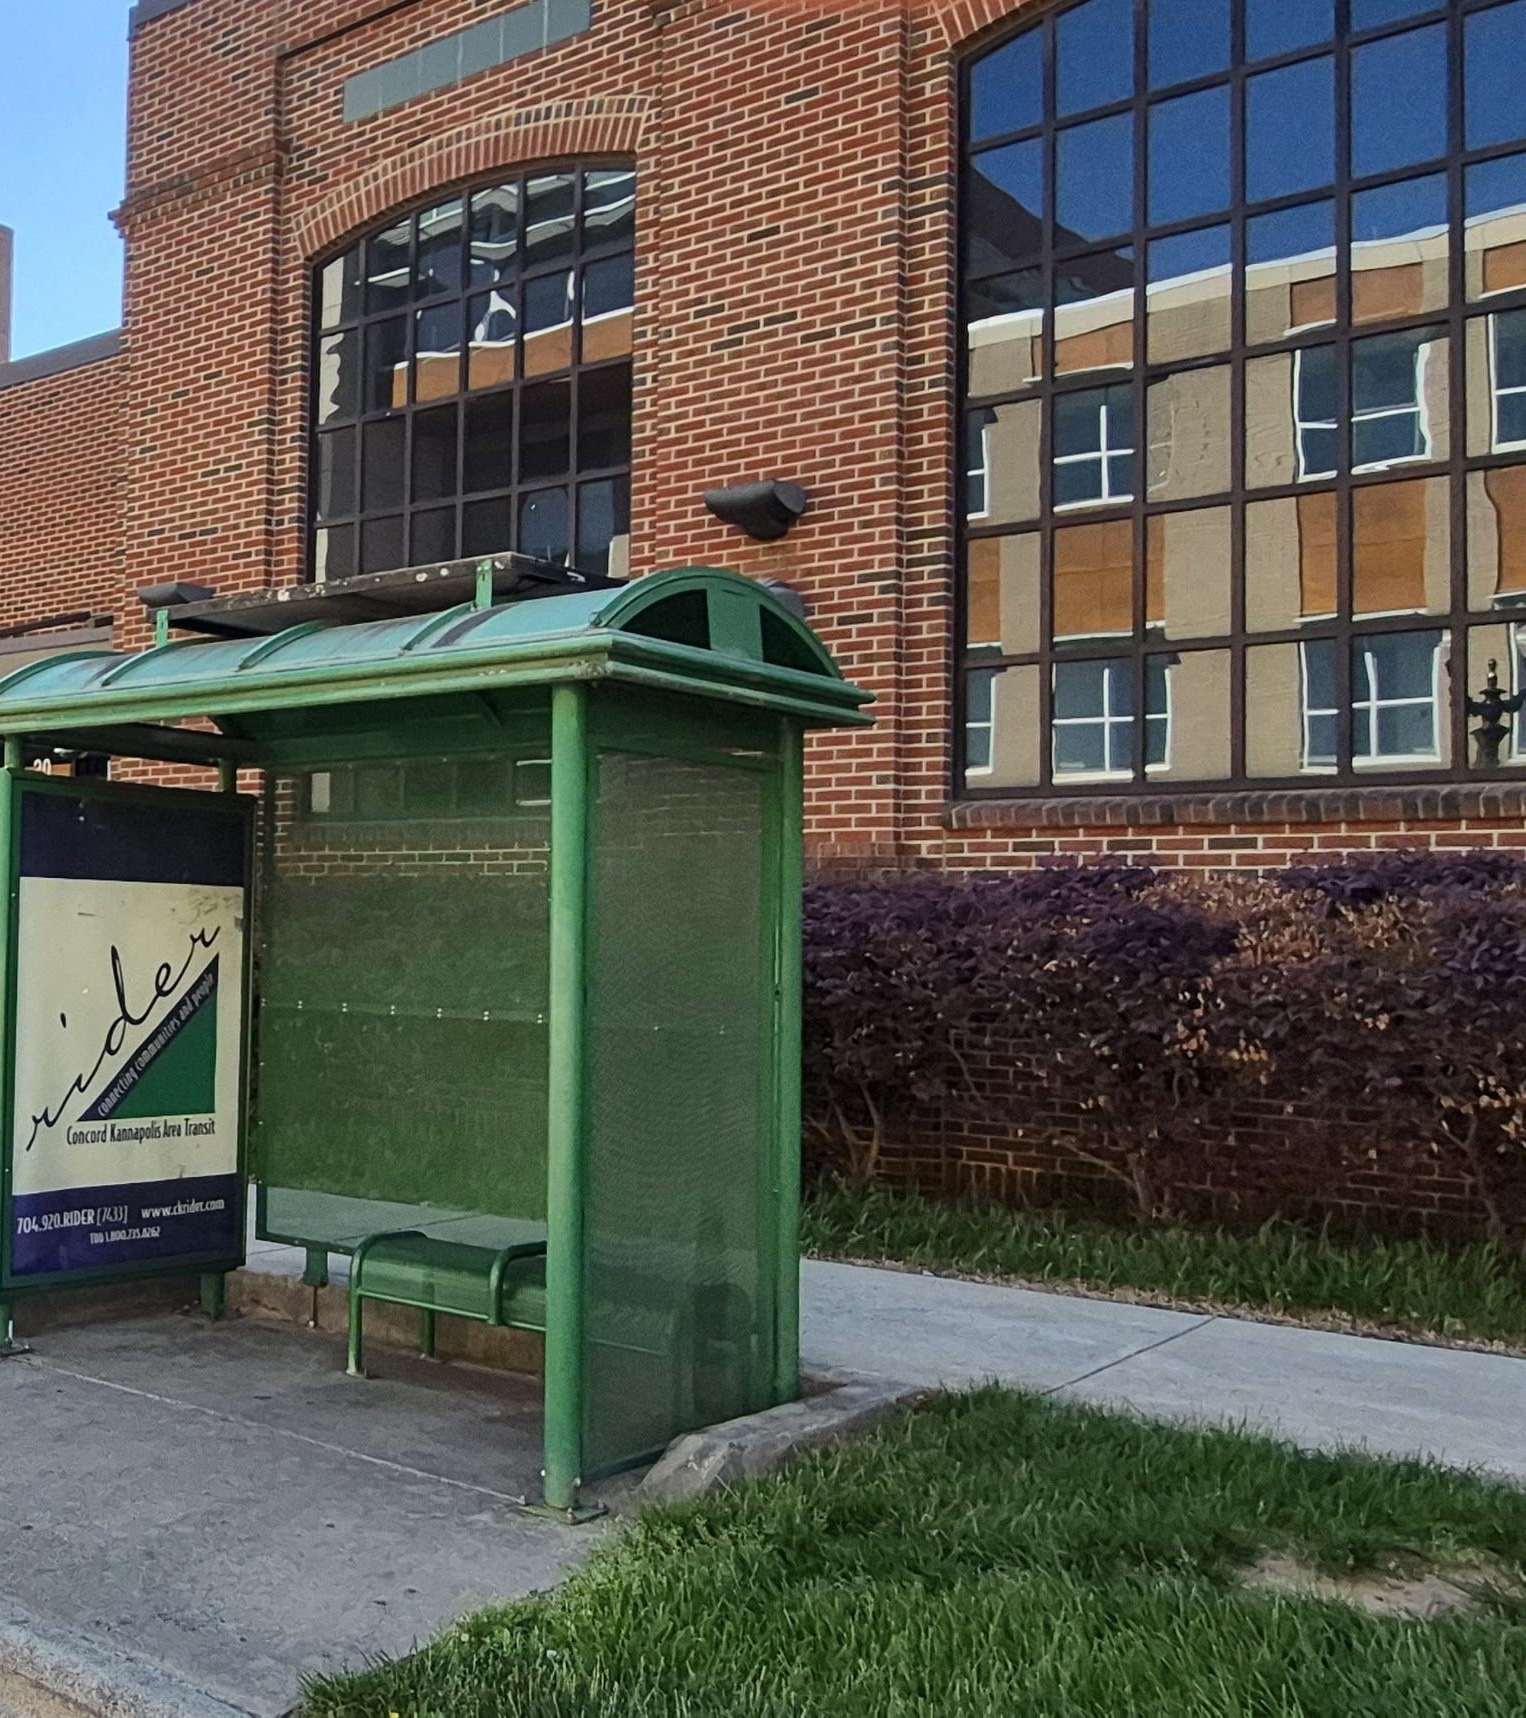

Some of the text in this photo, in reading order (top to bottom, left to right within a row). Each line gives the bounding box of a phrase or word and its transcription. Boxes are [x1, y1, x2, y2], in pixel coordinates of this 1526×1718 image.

[25, 925, 221, 1151] rider
[97, 972, 215, 1117] connecting communities and people
[67, 1117, 216, 1145] Concord Kannapolis Area Transit
[17, 1209, 95, 1235] 704.920.RIDER
[141, 1199, 225, 1219] www.ckrider.com
